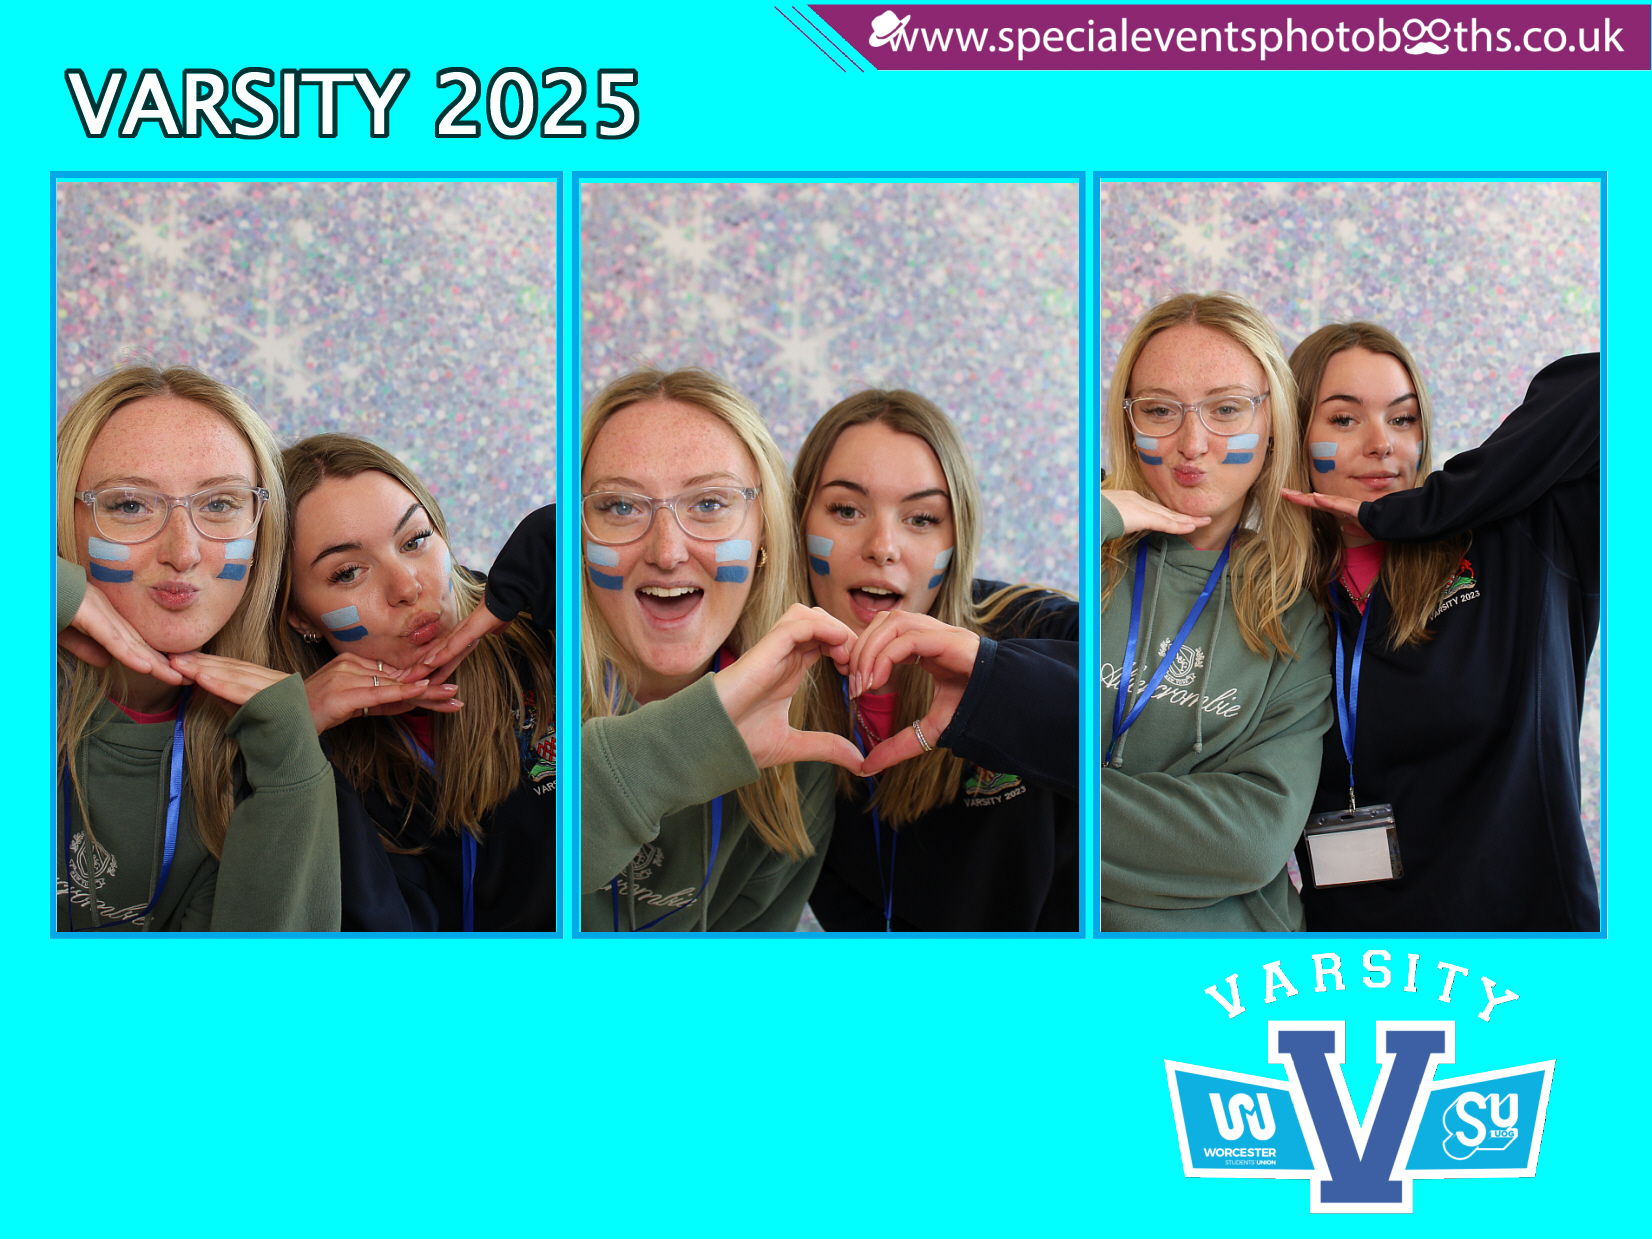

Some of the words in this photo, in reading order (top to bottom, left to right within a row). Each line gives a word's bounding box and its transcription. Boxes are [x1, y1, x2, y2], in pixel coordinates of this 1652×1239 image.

[1460, 590, 1481, 603] 2023
[963, 795, 1002, 808] VARSITY
[1004, 785, 1027, 801] 2023
